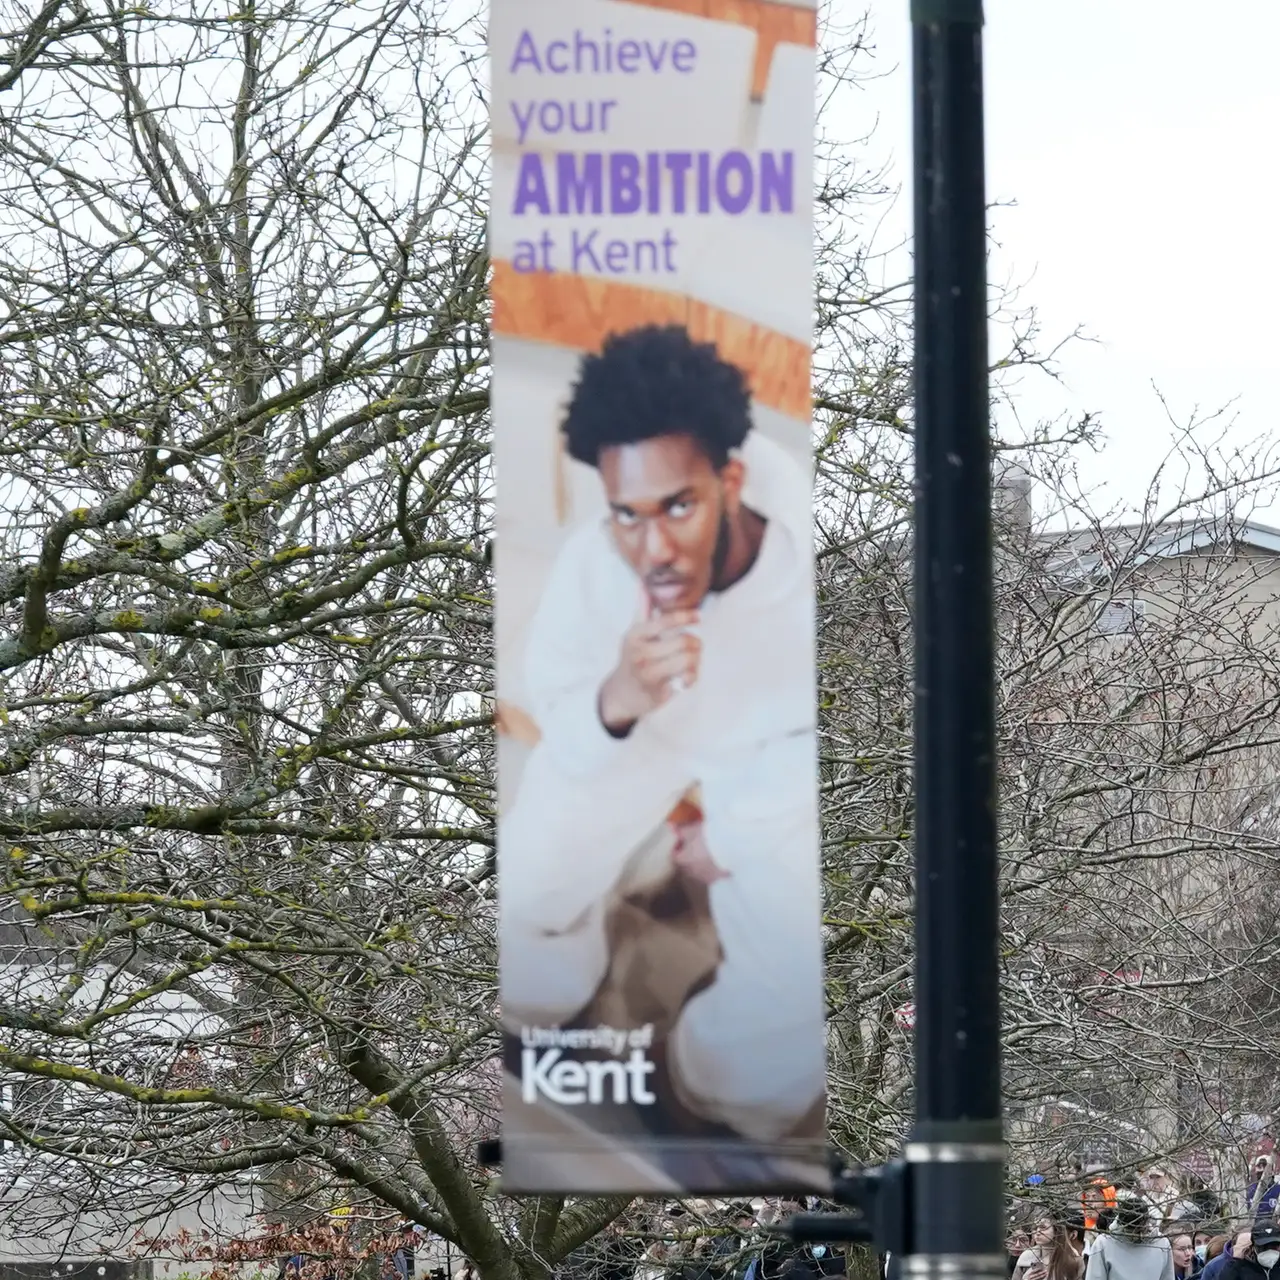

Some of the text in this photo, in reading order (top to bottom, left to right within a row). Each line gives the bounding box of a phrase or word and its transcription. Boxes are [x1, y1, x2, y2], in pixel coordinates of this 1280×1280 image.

[509, 28, 698, 75] Achieve
[509, 99, 618, 145] your
[512, 150, 794, 217] AMBITION
[512, 228, 679, 274] at Kent
[520, 1022, 654, 1056] University of
[520, 1048, 656, 1105] Kent
